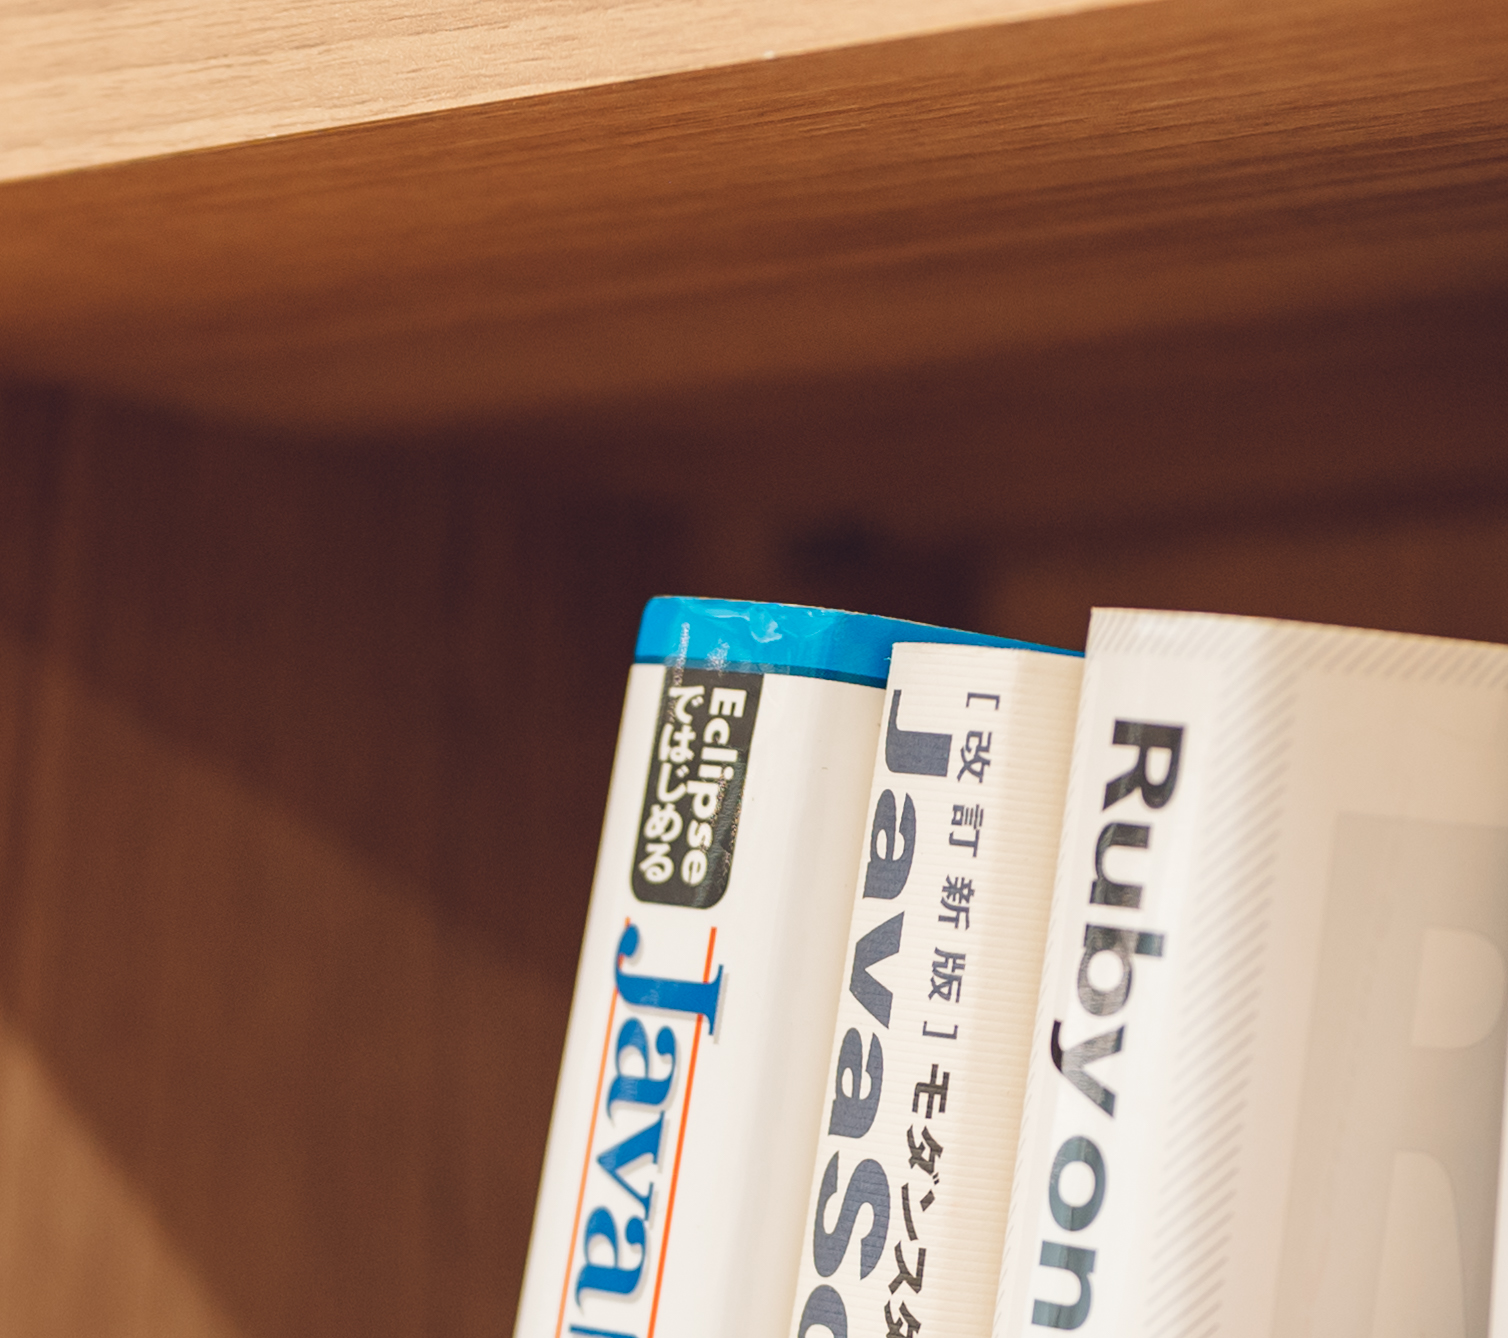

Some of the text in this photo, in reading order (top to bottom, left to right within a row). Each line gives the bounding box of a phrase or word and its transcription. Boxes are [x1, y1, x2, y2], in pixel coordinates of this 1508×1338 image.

[638, 685, 705, 884] ではじめる
[681, 686, 747, 885] Eclipse
[1050, 717, 1189, 1120] Ruby
[1030, 1135, 1106, 1332] on
